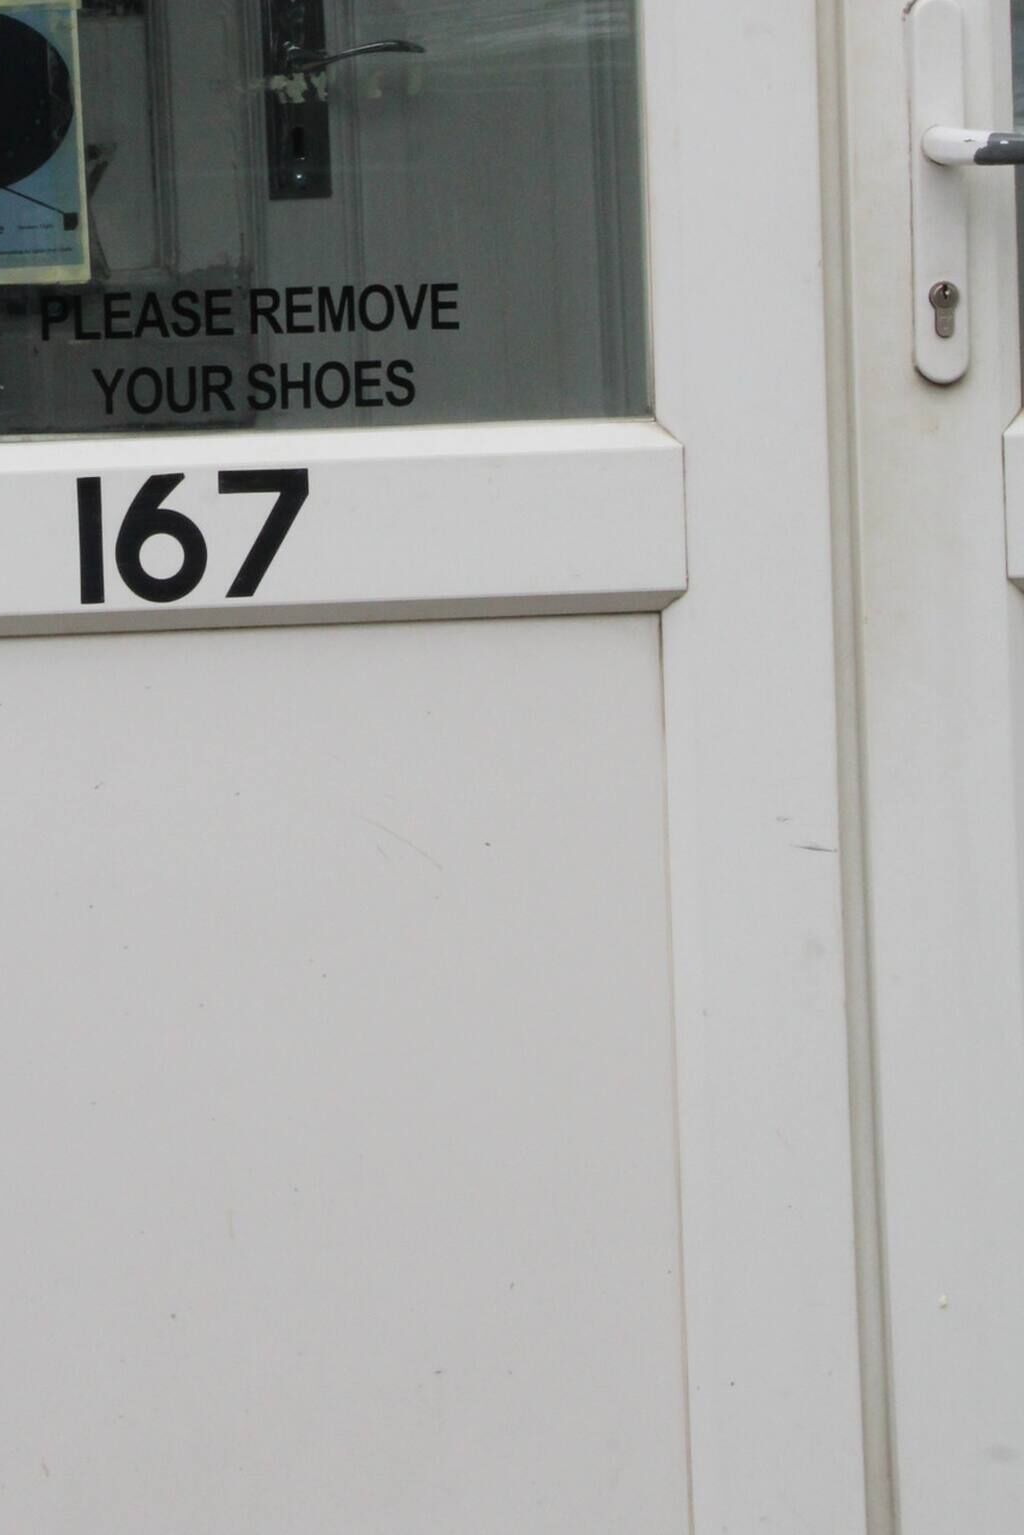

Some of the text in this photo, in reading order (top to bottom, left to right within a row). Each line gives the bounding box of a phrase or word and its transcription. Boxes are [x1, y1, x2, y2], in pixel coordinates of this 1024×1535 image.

[40, 283, 461, 341] PLEASE REMOVE
[92, 359, 416, 415] YOUR SHOES
[76, 467, 310, 604] 167
